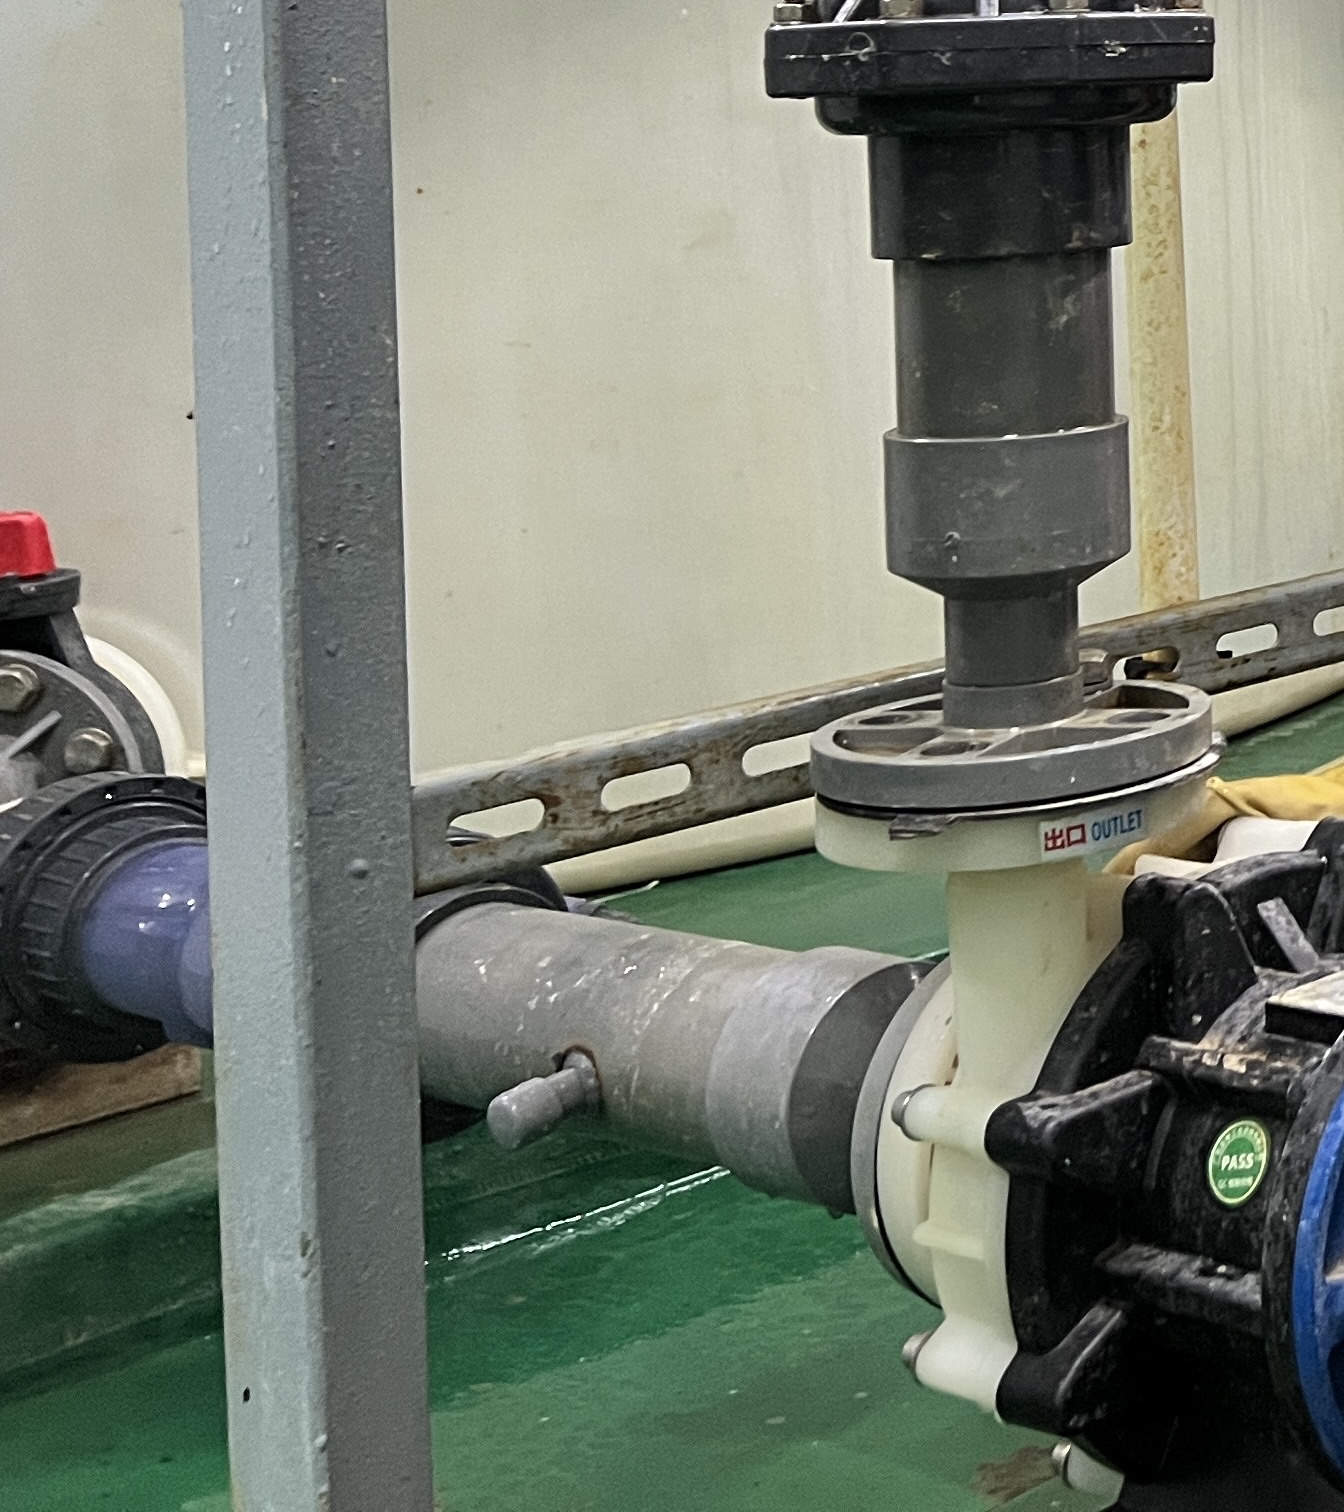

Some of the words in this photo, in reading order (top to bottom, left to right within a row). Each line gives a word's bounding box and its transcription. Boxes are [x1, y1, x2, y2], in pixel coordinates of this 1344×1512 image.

[1044, 823, 1086, 851] 出口
[1091, 809, 1143, 841] OUTLET
[1220, 1152, 1255, 1171] PASS
